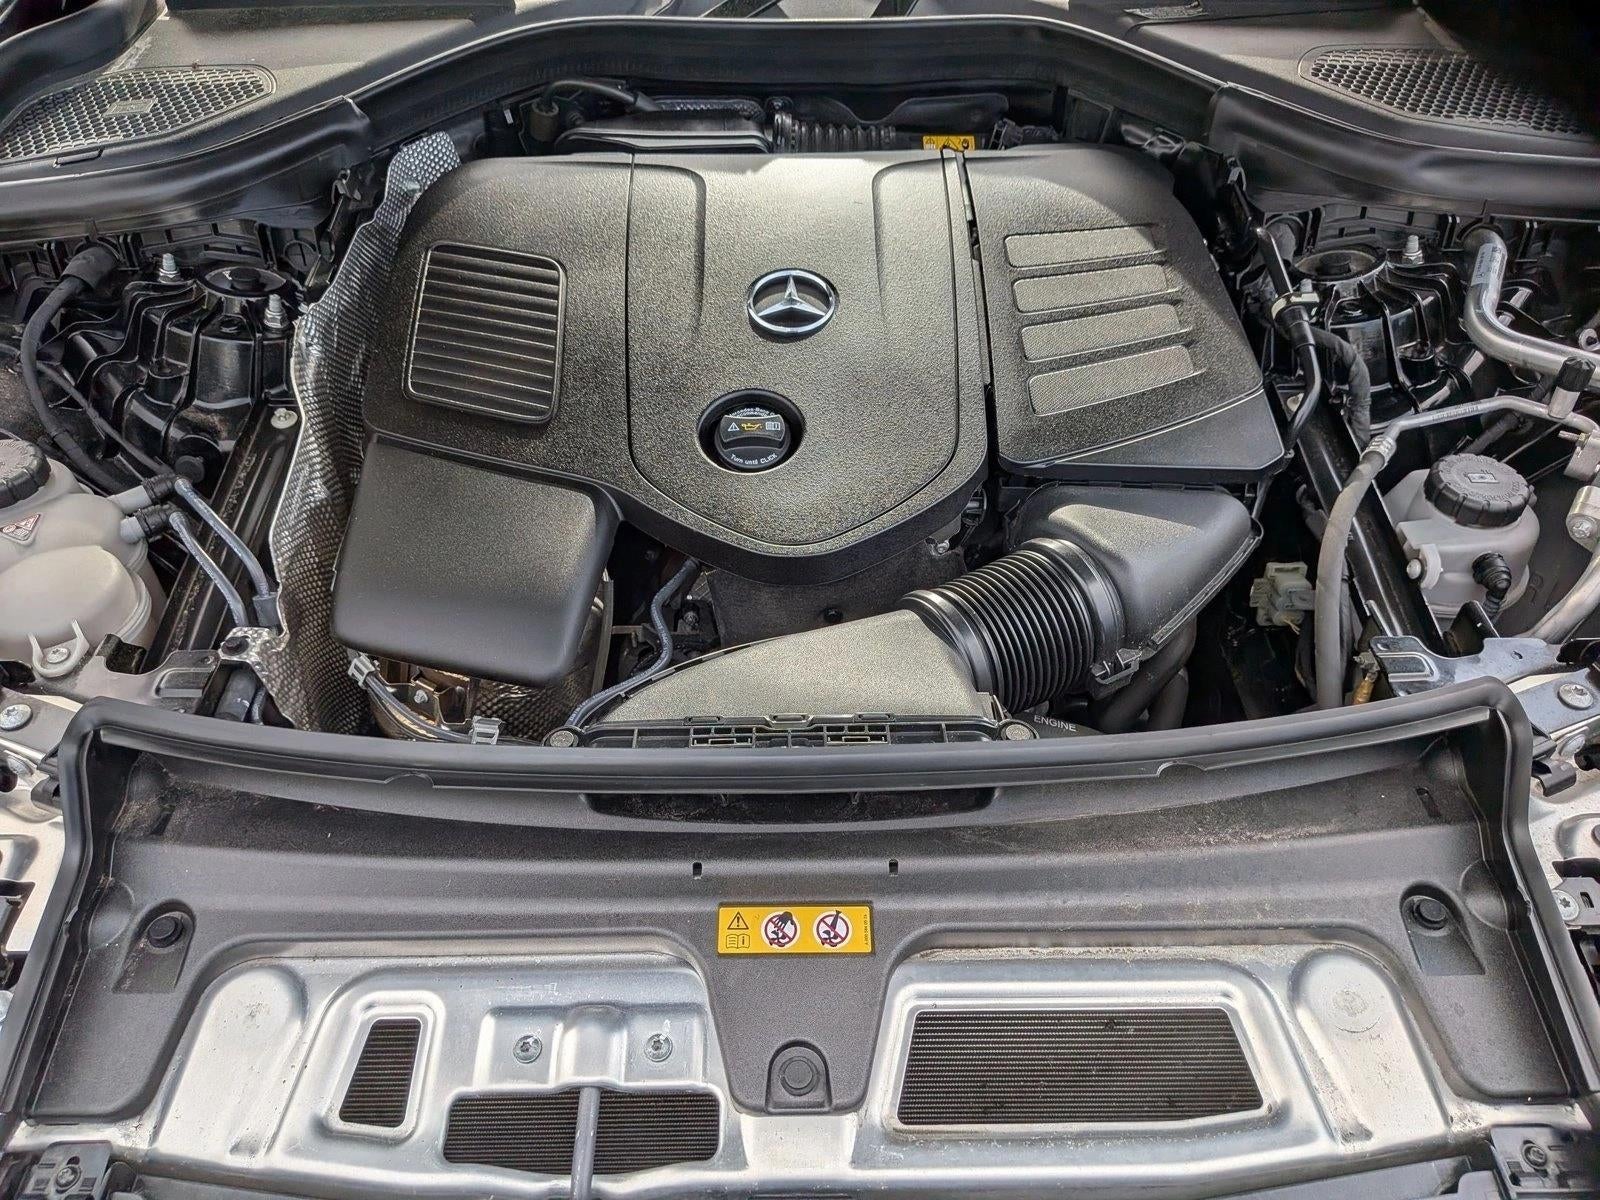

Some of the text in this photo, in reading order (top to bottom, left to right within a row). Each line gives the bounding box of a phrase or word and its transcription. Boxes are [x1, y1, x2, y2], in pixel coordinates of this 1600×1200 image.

[730, 453, 743, 464] Turn
[760, 452, 778, 464] CLICK
[1034, 715, 1077, 731] ENGINE
